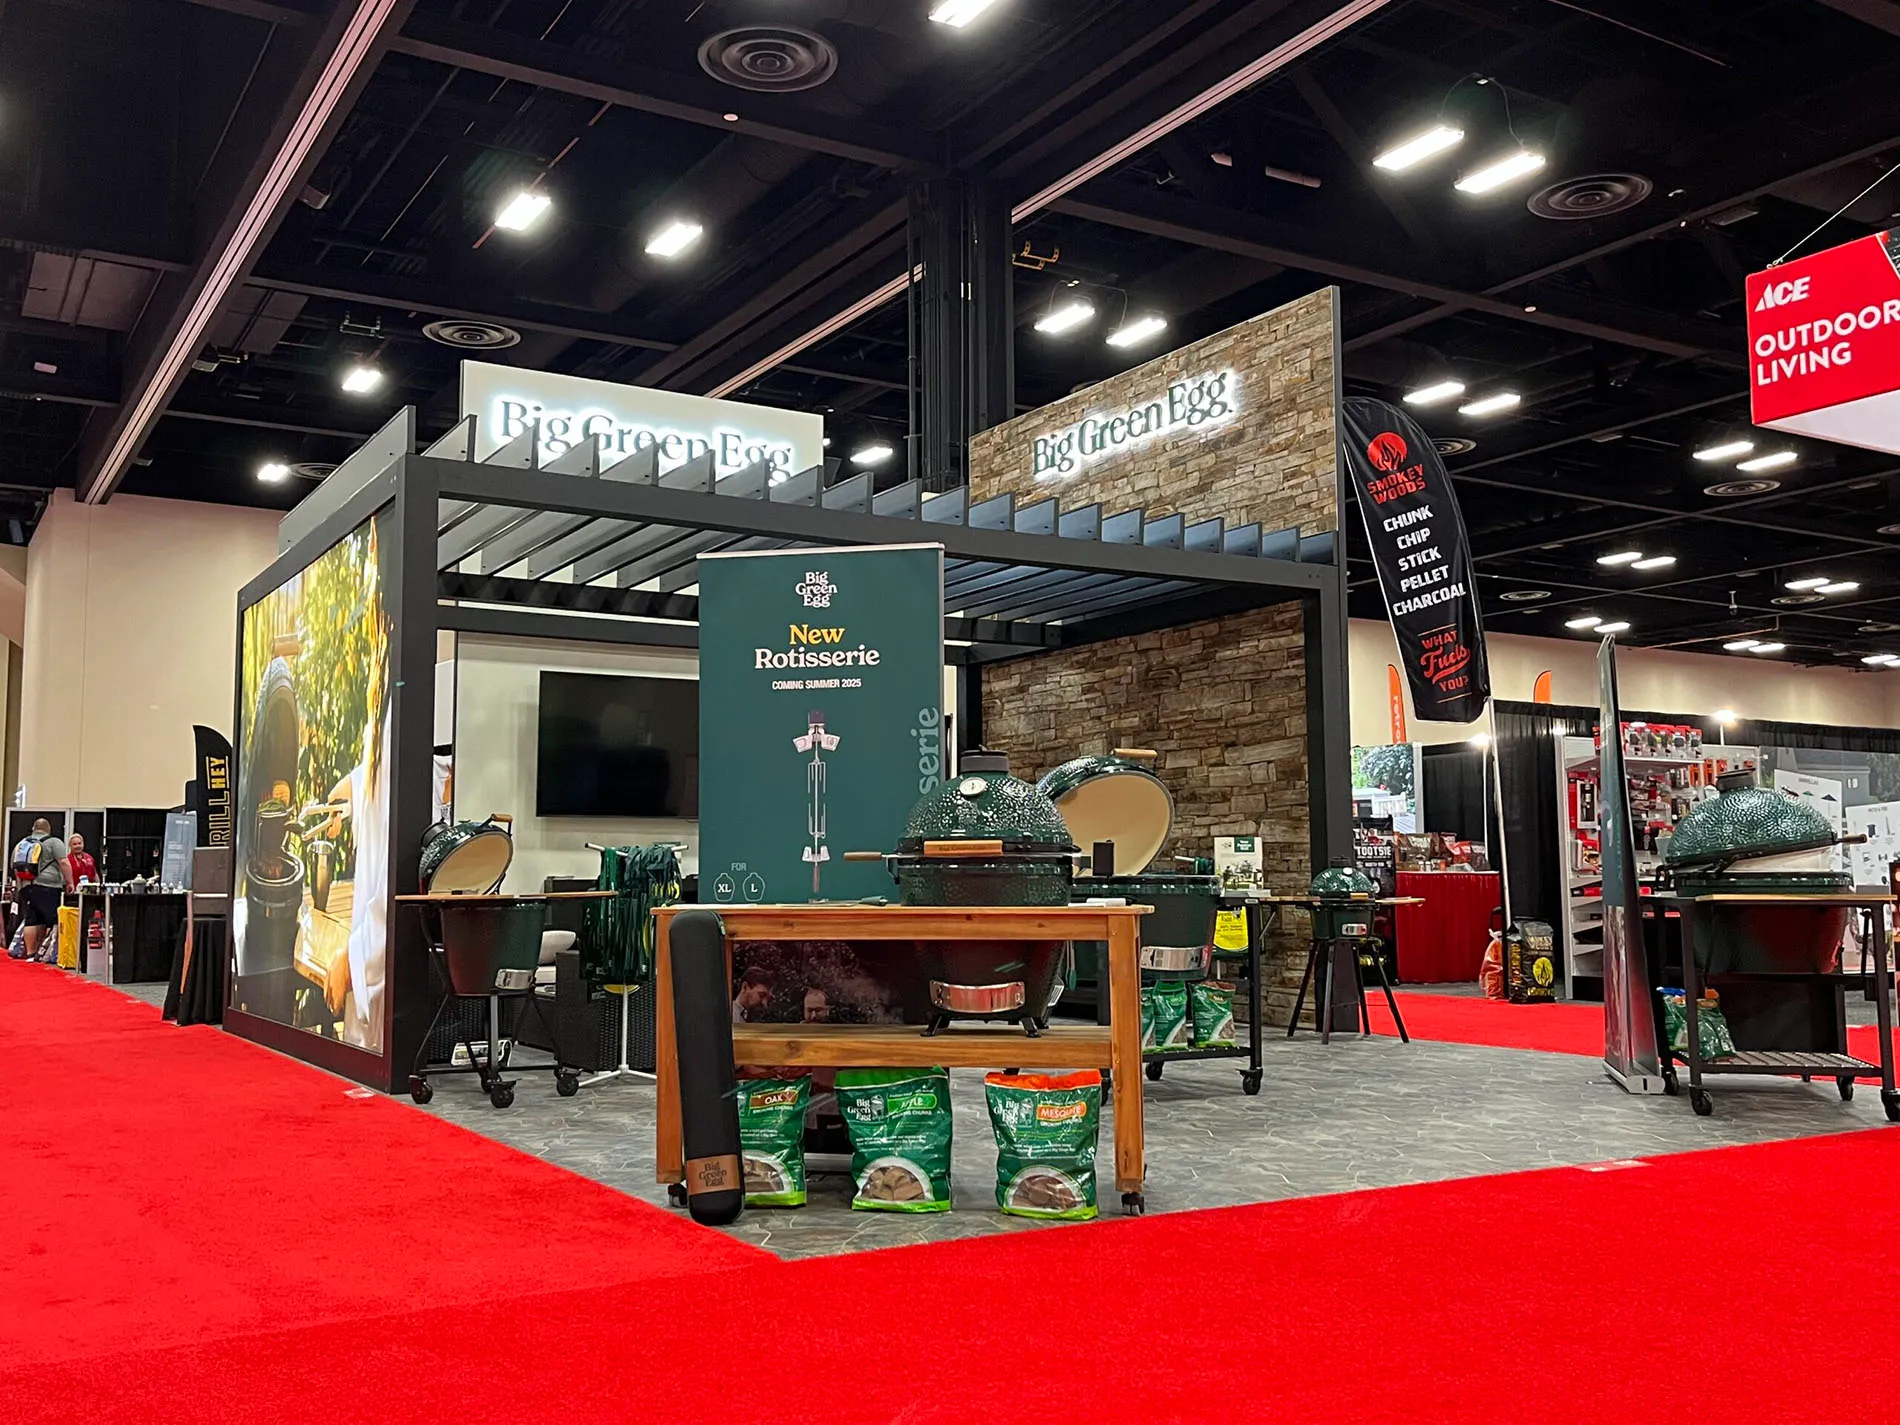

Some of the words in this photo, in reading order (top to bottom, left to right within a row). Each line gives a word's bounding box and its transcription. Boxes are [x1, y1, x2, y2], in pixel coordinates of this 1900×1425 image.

[1754, 276, 1811, 312] ACE
[1755, 299, 1900, 357] OUTDOOR
[1757, 342, 1852, 386] LIVING
[501, 400, 572, 454] Big
[582, 414, 710, 463] Green
[1033, 432, 1075, 475] Big
[1078, 402, 1163, 456] Green
[1367, 463, 1424, 494] SMOKEY
[1373, 477, 1426, 505] WOODS
[1383, 504, 1433, 533] CHUNK
[1396, 528, 1431, 551] CHIP
[1398, 546, 1442, 572] STICK
[795, 583, 838, 595] Green
[805, 571, 829, 585] Big
[1400, 565, 1449, 593] PELLET
[803, 594, 831, 608] Egg
[1392, 582, 1467, 617] CHARCOAL
[789, 624, 845, 645] New
[1422, 630, 1457, 649] WHAT
[755, 644, 880, 669] Rotisserie
[772, 681, 803, 690] COMING
[805, 680, 840, 689] SUMMER
[841, 678, 862, 688] 2025
[1439, 675, 1469, 692] YOU?
[209, 757, 226, 789] HEY
[731, 863, 747, 871] FOR
[717, 884, 732, 893] XL
[751, 884, 758, 893] L
